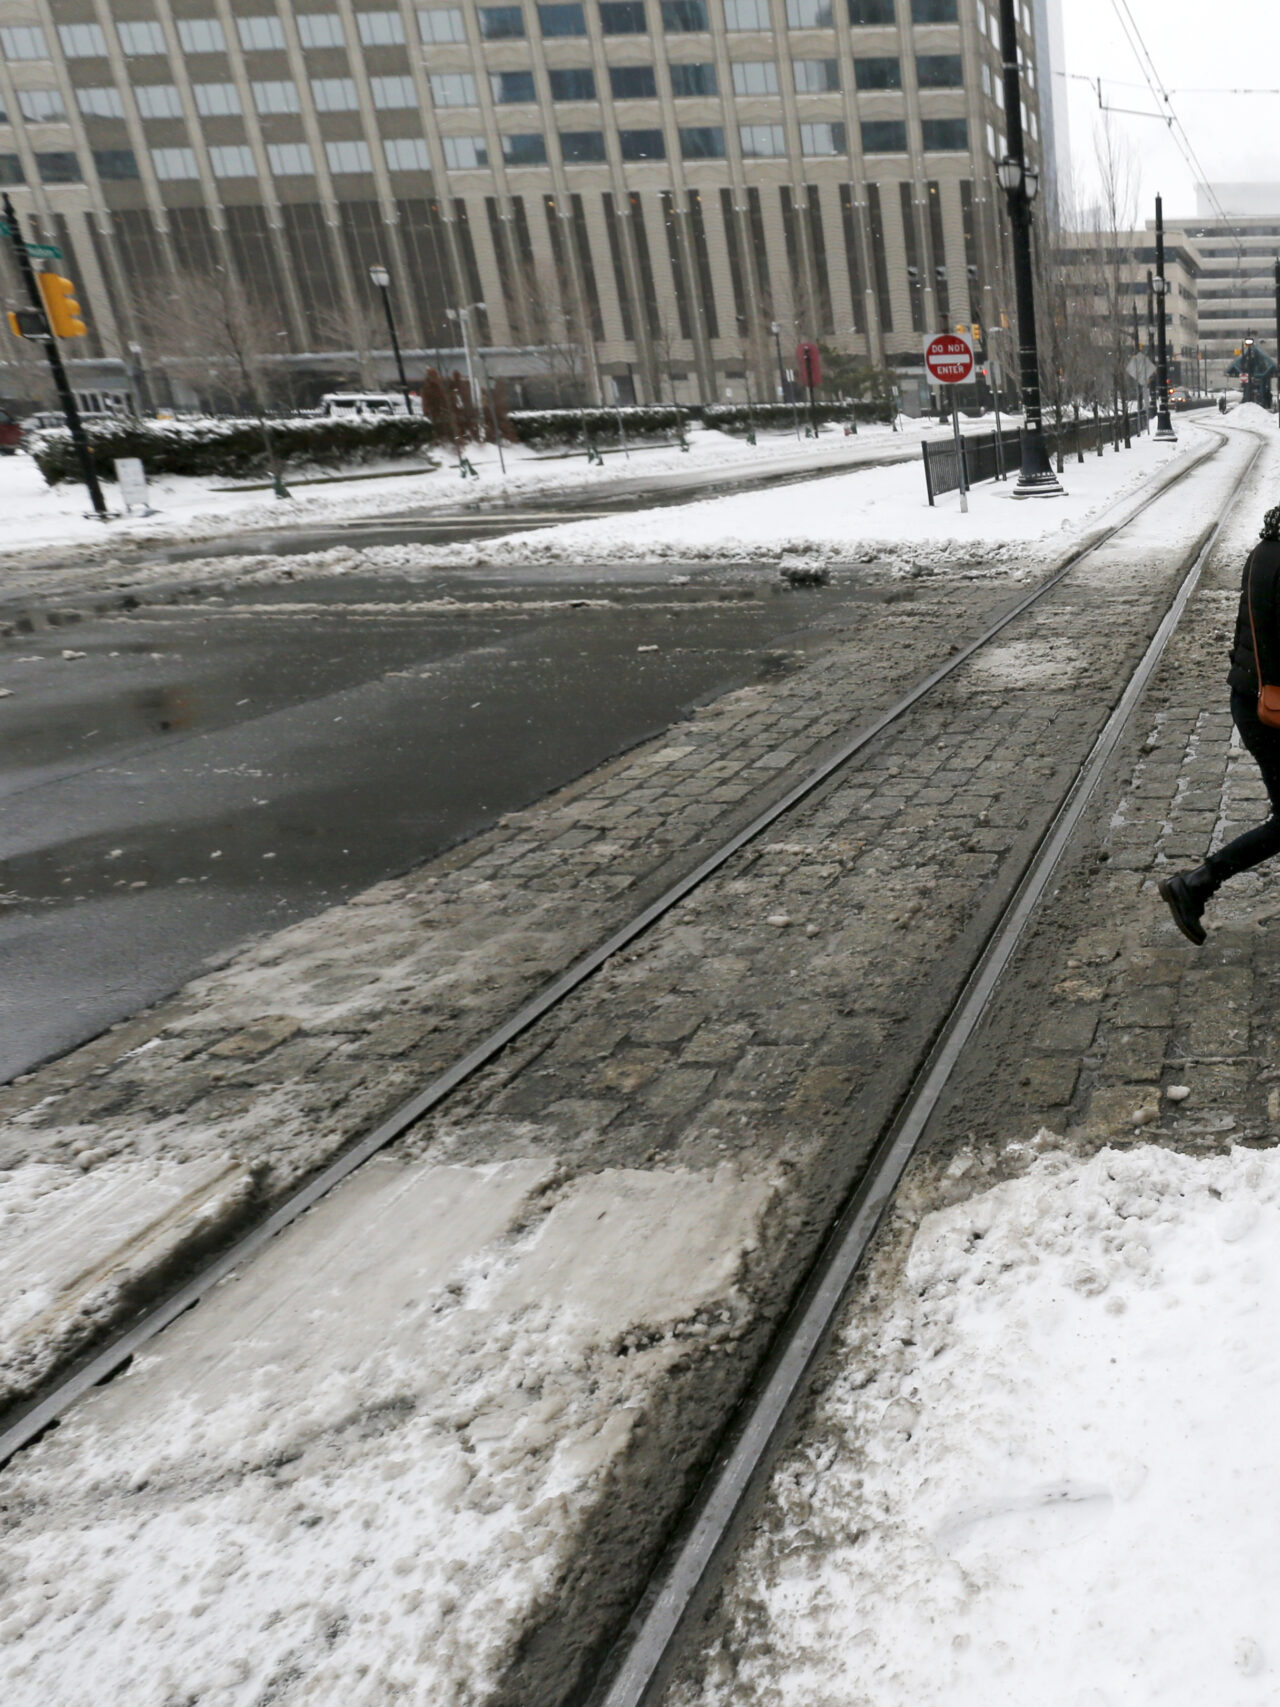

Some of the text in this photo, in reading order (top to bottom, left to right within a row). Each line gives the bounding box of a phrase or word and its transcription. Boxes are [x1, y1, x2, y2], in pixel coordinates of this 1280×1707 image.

[931, 343, 965, 353] DO NOT
[937, 365, 965, 375] ENTER
